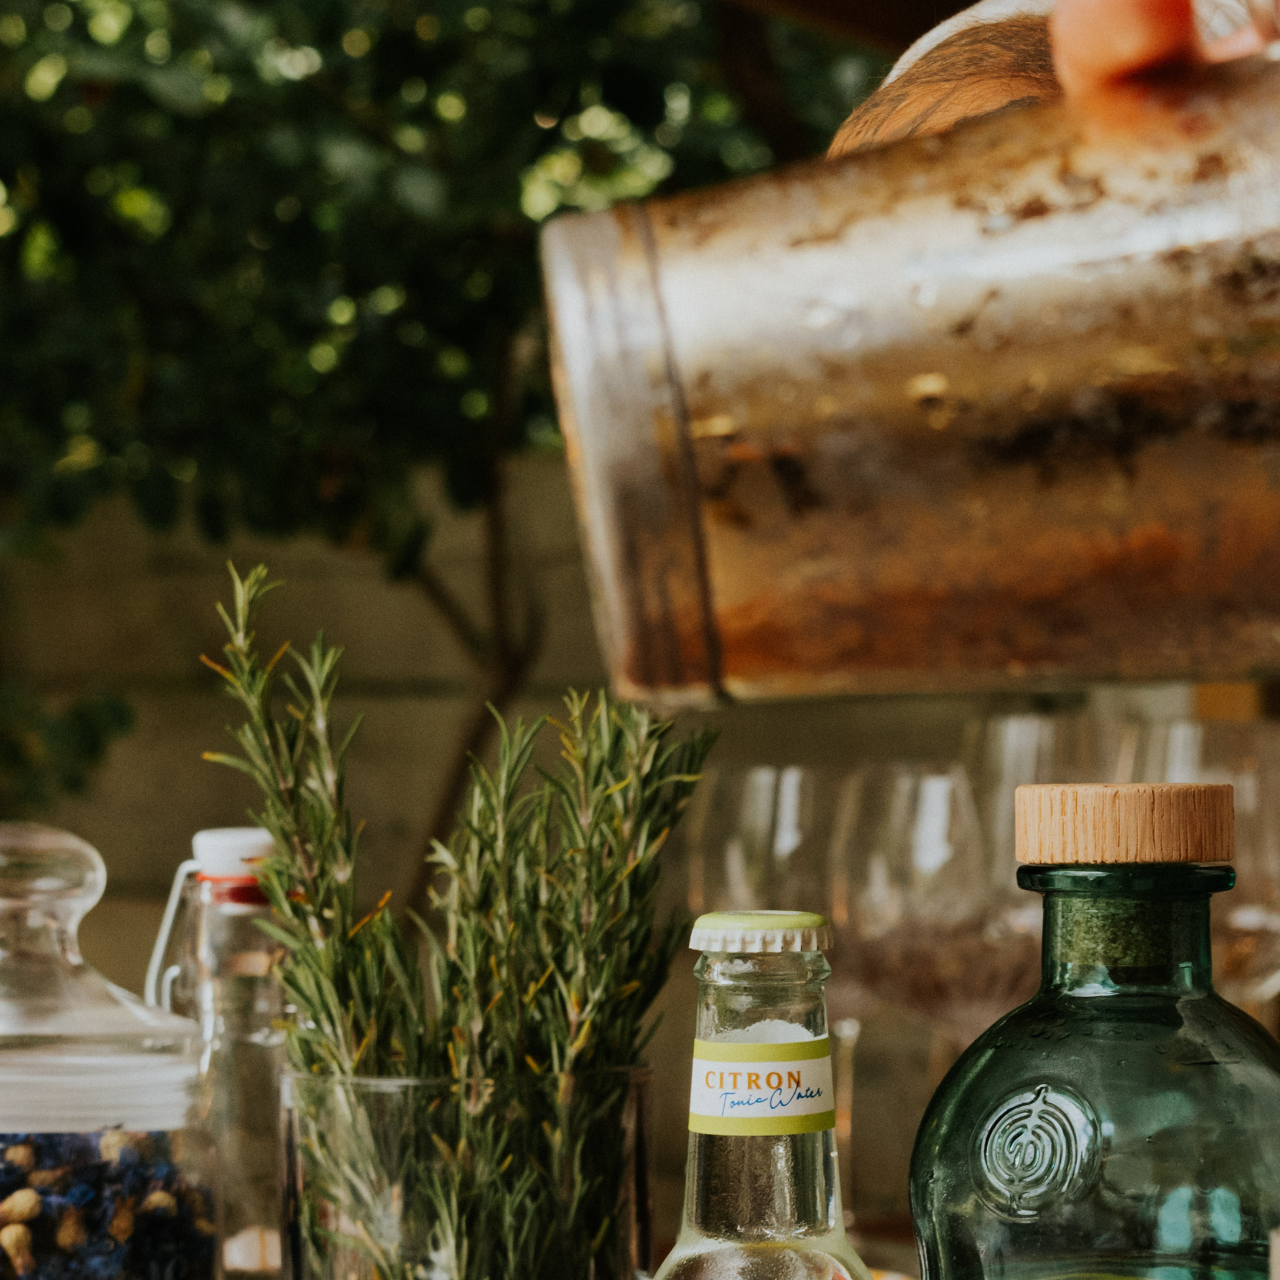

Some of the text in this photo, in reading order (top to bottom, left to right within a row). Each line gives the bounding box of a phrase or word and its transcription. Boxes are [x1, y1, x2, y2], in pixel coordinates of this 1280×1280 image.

[705, 1070, 802, 1091] CITRON
[719, 1081, 824, 1117] Tonic Water
